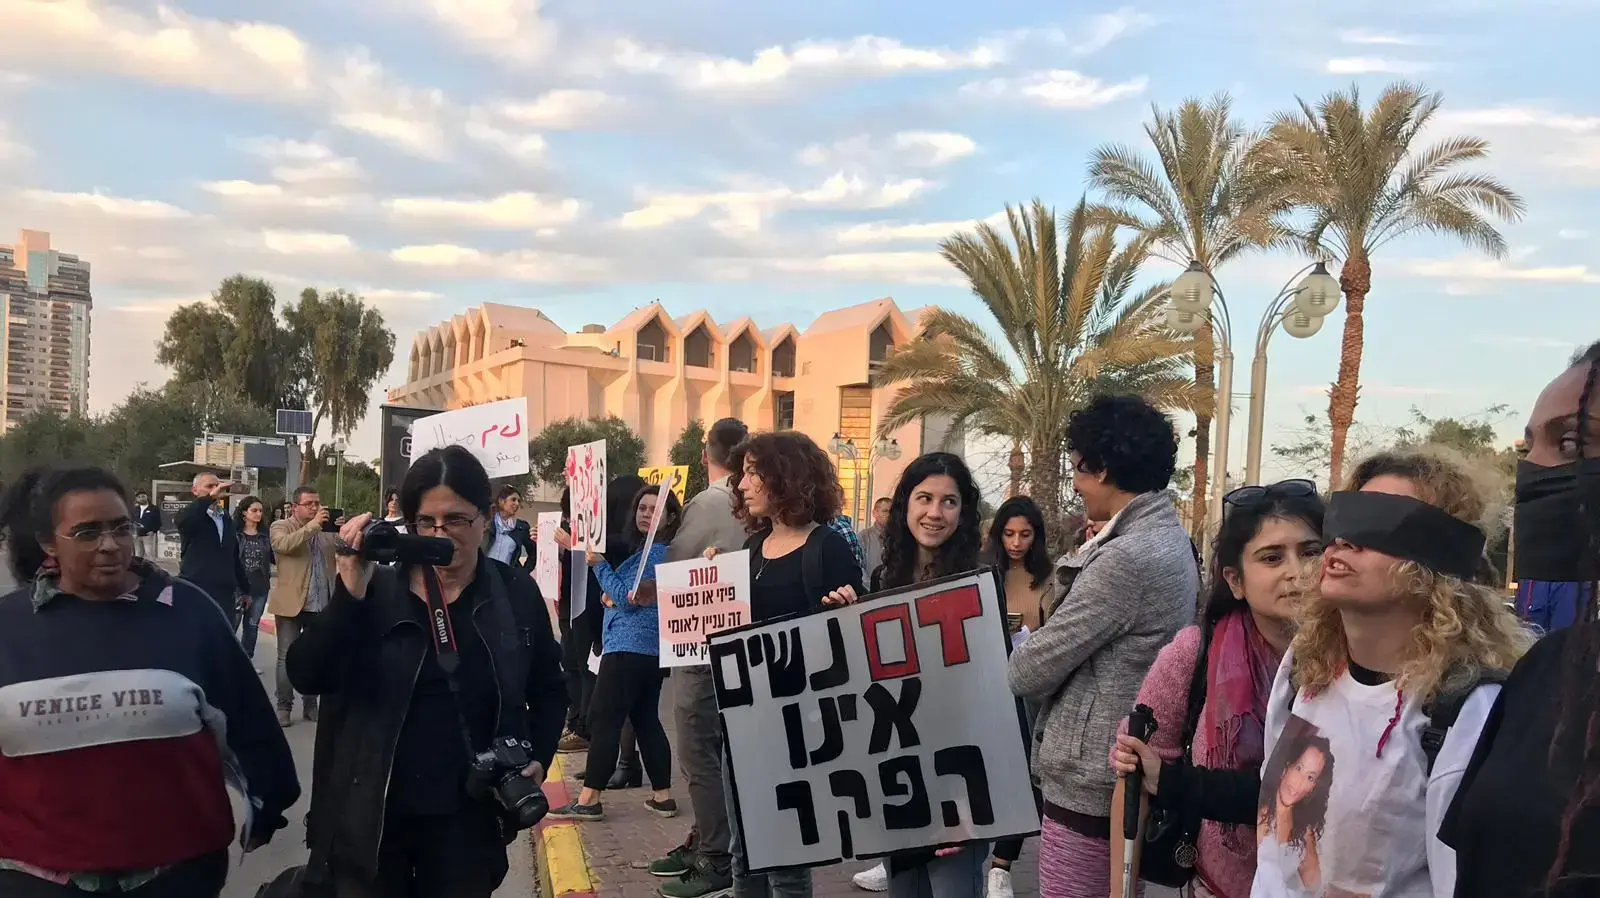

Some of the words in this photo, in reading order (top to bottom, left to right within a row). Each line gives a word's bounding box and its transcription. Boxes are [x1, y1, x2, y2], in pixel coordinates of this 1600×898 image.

[689, 565, 718, 587] מוות
[671, 592, 699, 608] נפשי
[703, 589, 714, 605] או
[717, 586, 736, 602] פיזי
[435, 609, 448, 643] Canon
[667, 614, 699, 634] לאומי
[702, 613, 725, 635] עניין
[728, 611, 741, 627] זה
[860, 584, 983, 682] דם
[672, 642, 698, 657] אישי
[709, 617, 849, 710] נשים
[19, 694, 103, 718] VENICE
[112, 689, 164, 708] VIBE
[782, 676, 922, 770] אינו
[775, 745, 995, 859] הפקר
